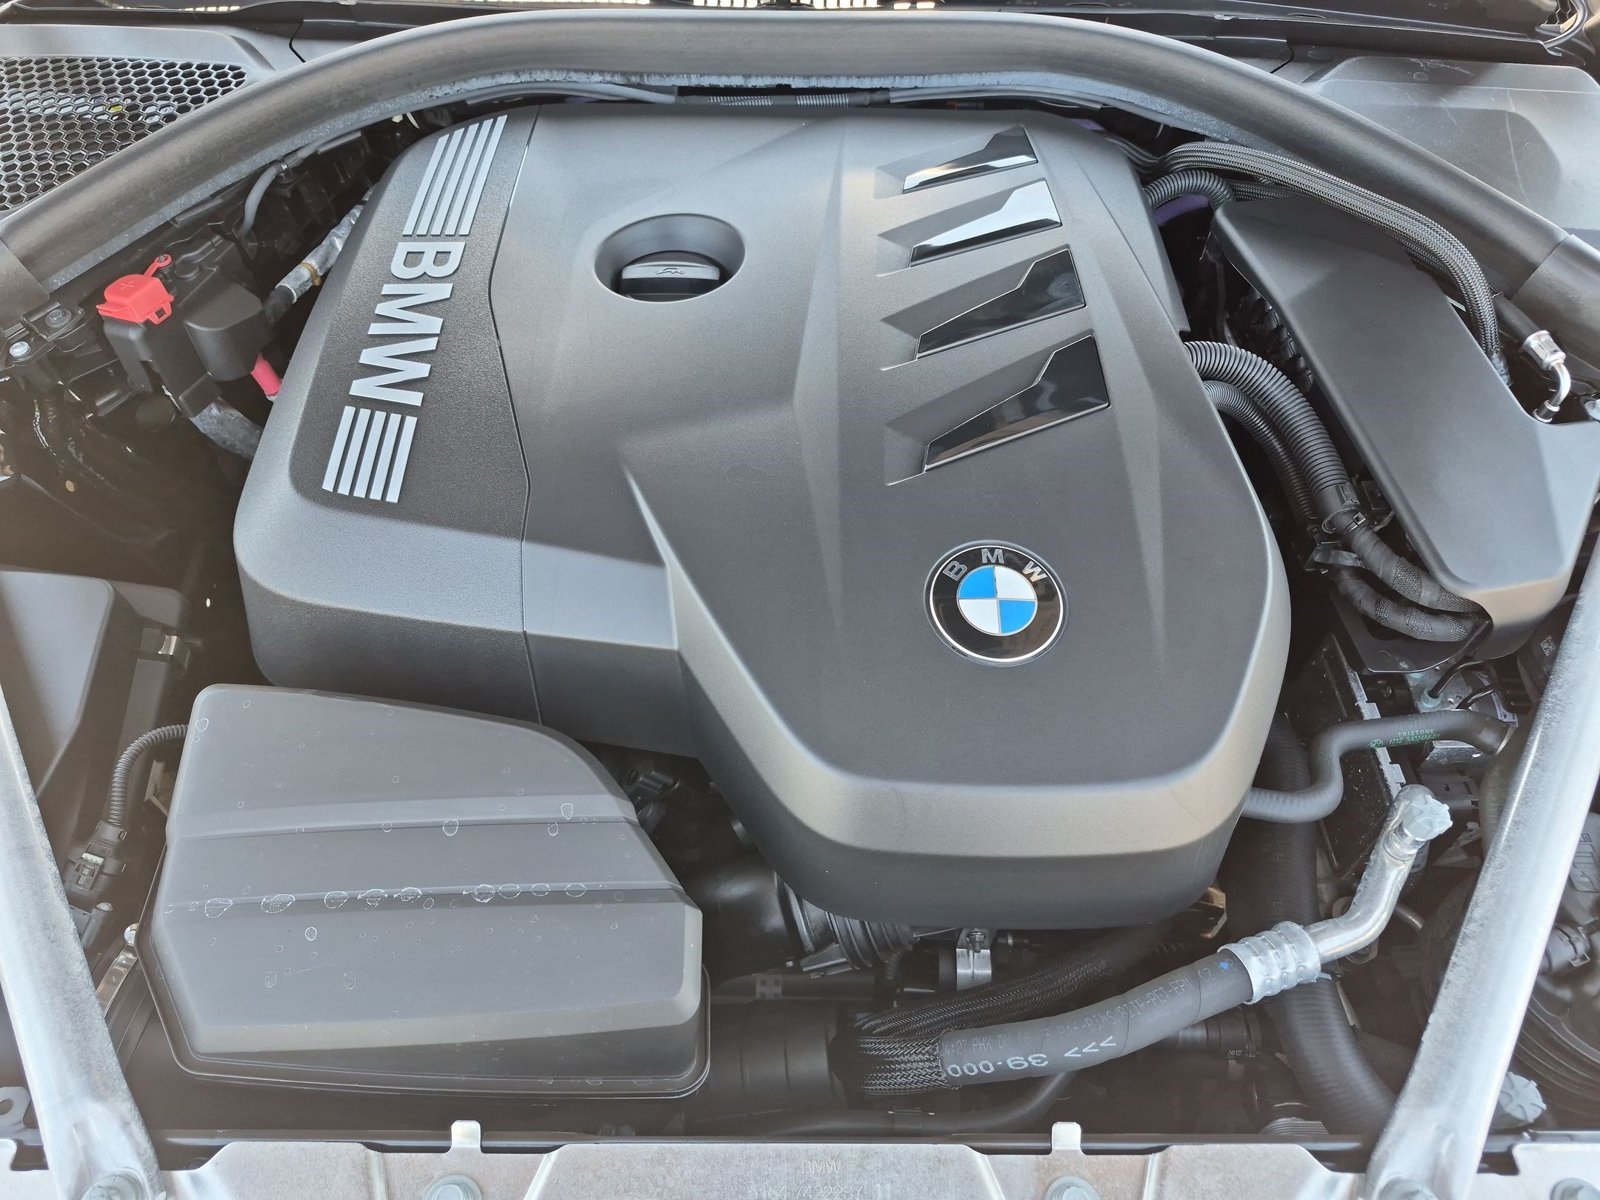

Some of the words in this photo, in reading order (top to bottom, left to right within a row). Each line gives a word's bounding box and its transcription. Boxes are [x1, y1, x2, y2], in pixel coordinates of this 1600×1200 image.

[349, 241, 466, 407] BMW
[943, 548, 1048, 582] BMW
[801, 1159, 841, 1174] BMW
